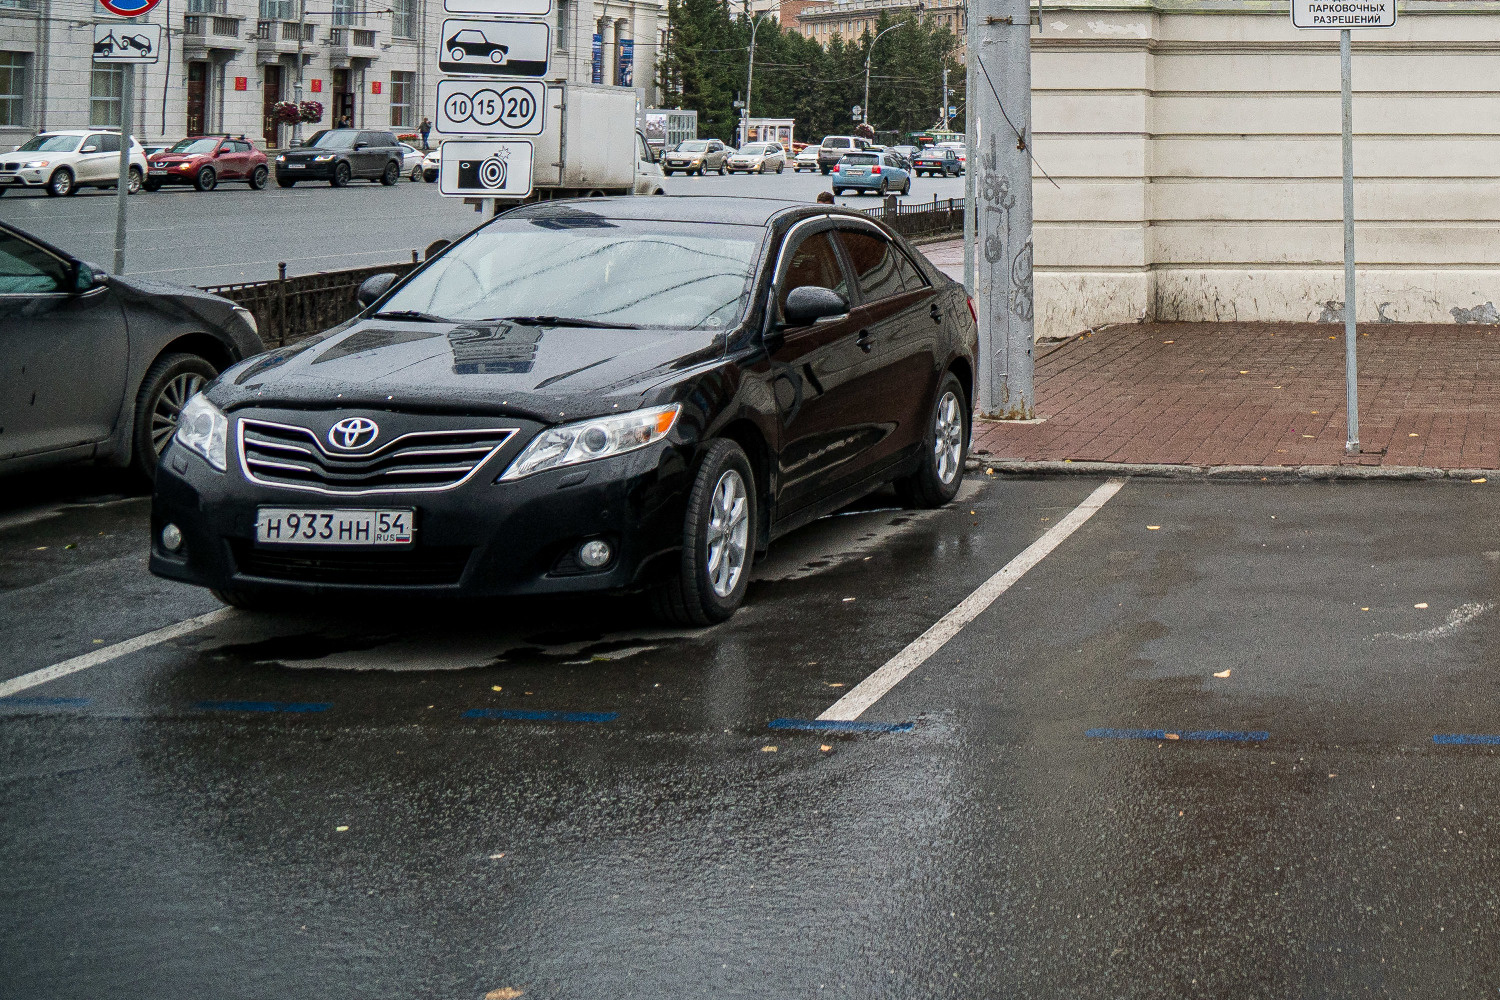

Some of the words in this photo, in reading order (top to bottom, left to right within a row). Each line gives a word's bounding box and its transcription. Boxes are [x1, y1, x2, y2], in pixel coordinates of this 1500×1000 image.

[1308, 4, 1386, 13] ПАРКОВОЧНЫХ
[1313, 14, 1381, 24] РАЗРЕШЕНИЙ
[451, 100, 467, 115] 10
[477, 99, 495, 116] 15
[506, 97, 530, 118] 20
[378, 513, 404, 534] 54
[376, 534, 396, 542] RUS
